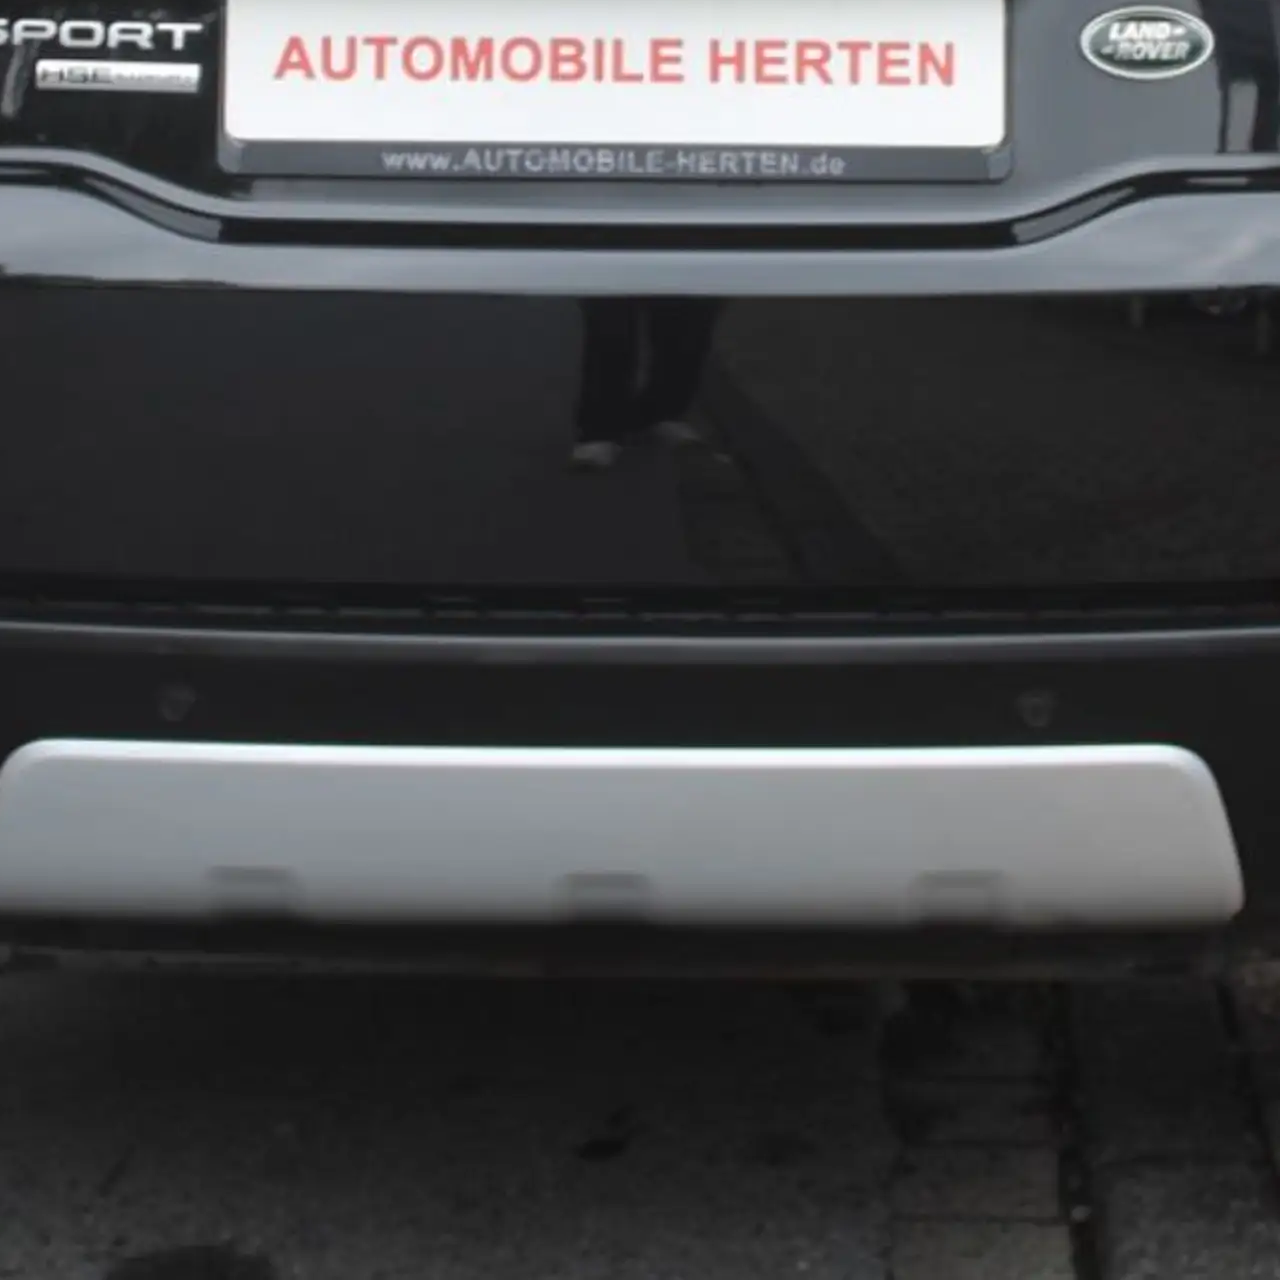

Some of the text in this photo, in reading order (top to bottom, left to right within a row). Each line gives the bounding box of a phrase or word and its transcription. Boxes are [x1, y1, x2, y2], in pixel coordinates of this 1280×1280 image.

[272, 35, 956, 87] AUTOMOBILE HERTEN
[381, 148, 846, 176] www.AUTOMOBILE-HERTEN.de
